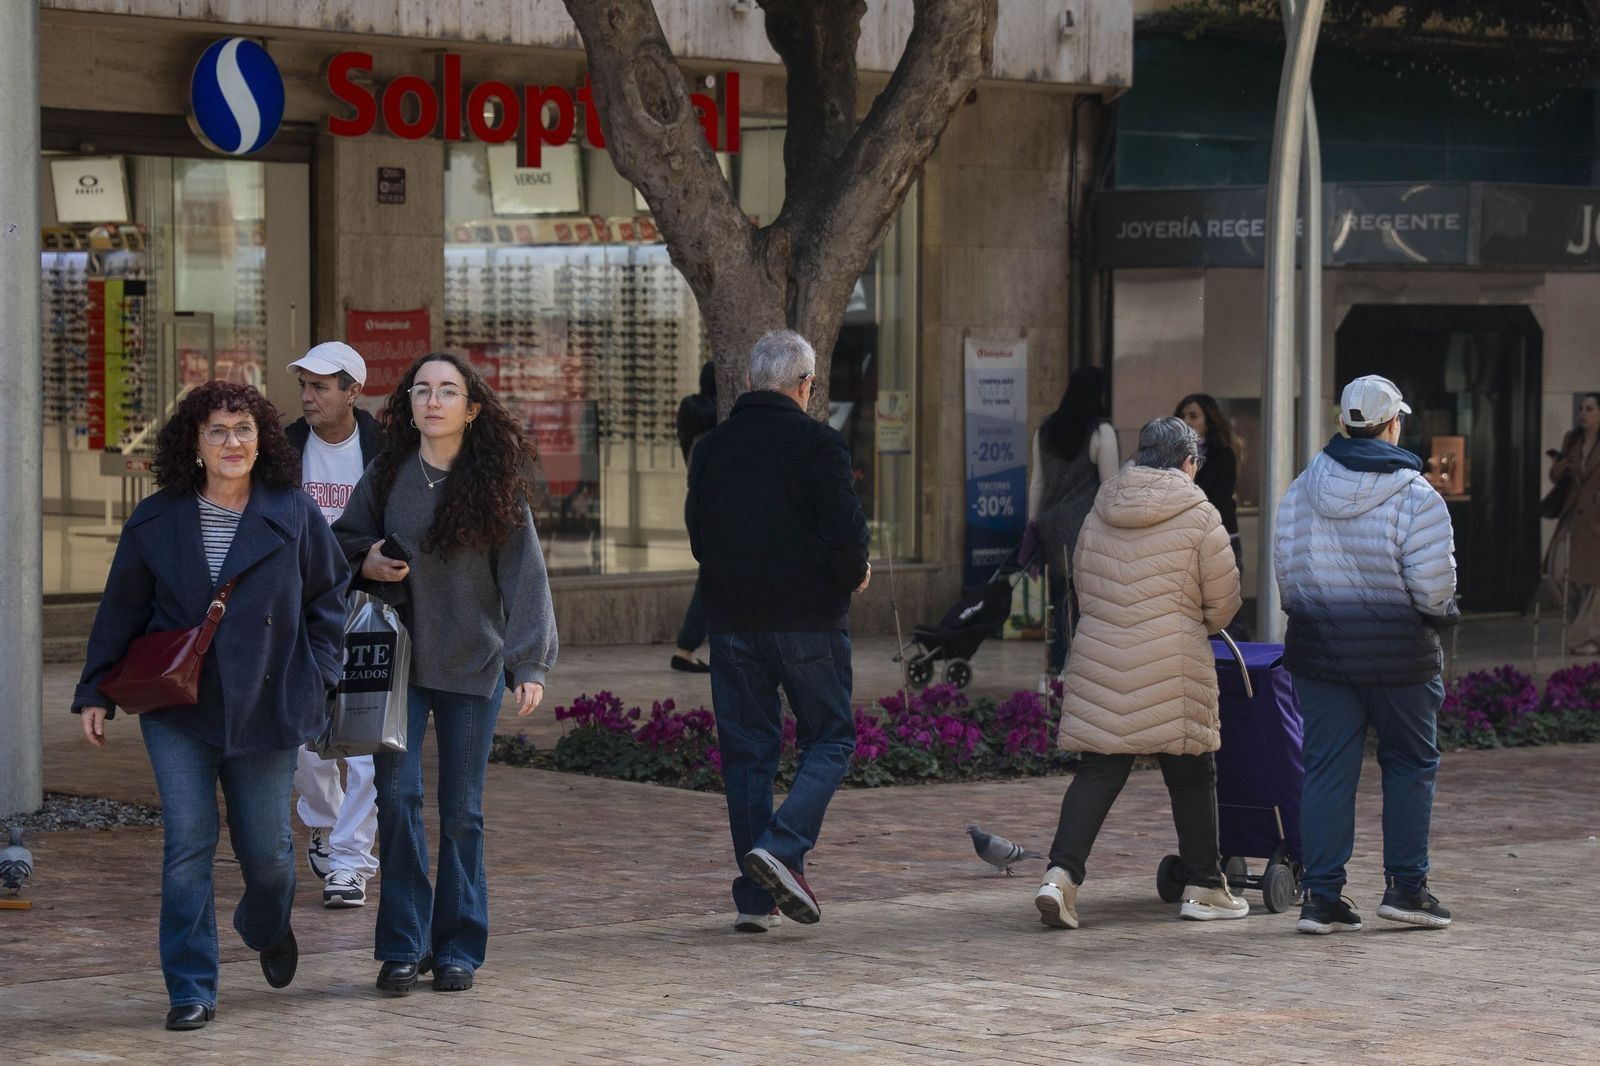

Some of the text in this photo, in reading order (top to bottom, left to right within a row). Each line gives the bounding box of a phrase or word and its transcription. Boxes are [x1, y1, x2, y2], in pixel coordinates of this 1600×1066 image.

[514, 173, 552, 185] VERSACE
[1116, 216, 1201, 239] JOYERÍA
[972, 442, 1014, 461] -20%
[971, 496, 1014, 517] -30%
